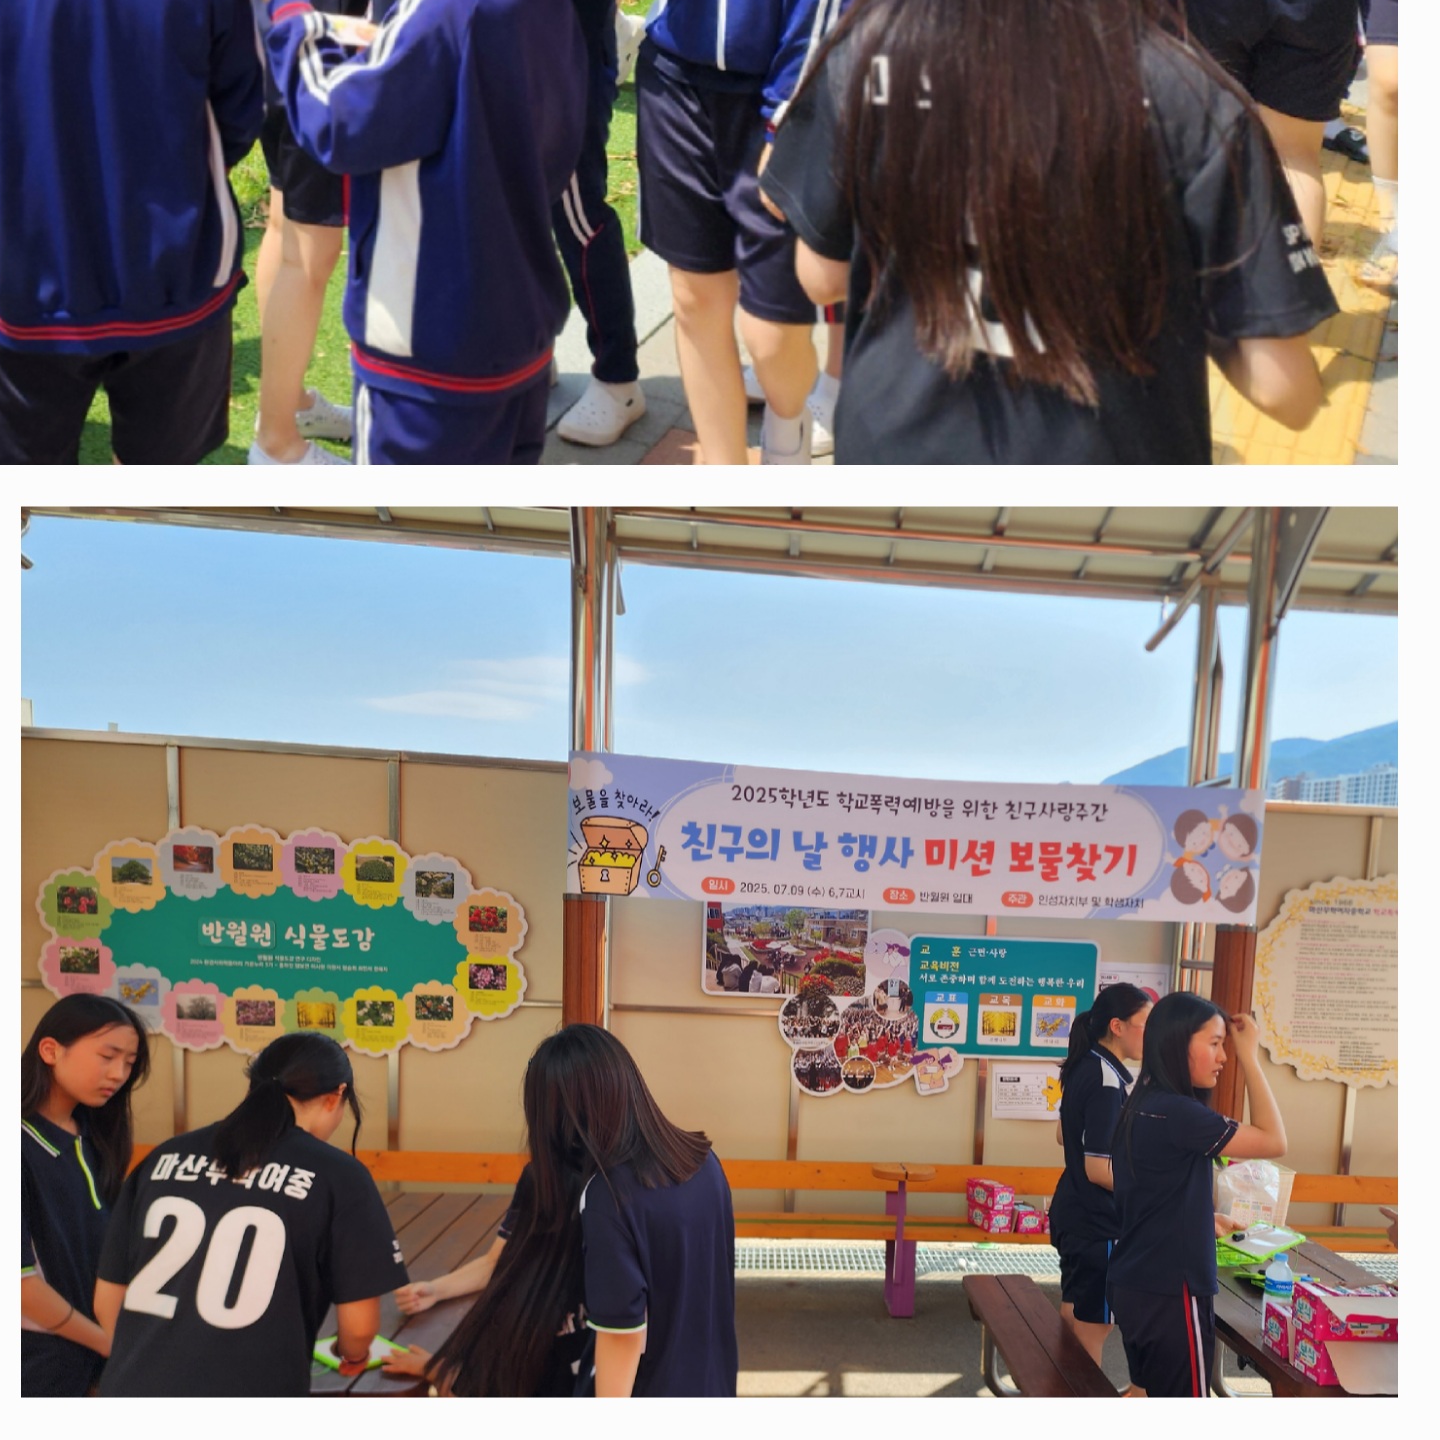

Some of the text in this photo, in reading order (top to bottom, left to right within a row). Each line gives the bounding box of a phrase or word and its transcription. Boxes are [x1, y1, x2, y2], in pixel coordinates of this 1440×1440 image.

[572, 788, 660, 823] 보물을 찾아라!
[731, 784, 1109, 823] 2025학년도 학교폭력예방을 위한 친구사랑주간
[681, 821, 1137, 883] 친구의 날 행사 미션 보물찾기
[707, 879, 1144, 909] 일시 2025. 07.09 (수) 6,7교시 장소 반월원 일대 주관 인성자치부 및 학생자치
[202, 920, 375, 952] 반월원 식물도감
[919, 973, 1085, 989] 서로 존중하며 함께 도전하는 행복한 우리
[920, 960, 959, 972] 교육비전
[124, 1195, 286, 1329] 20
